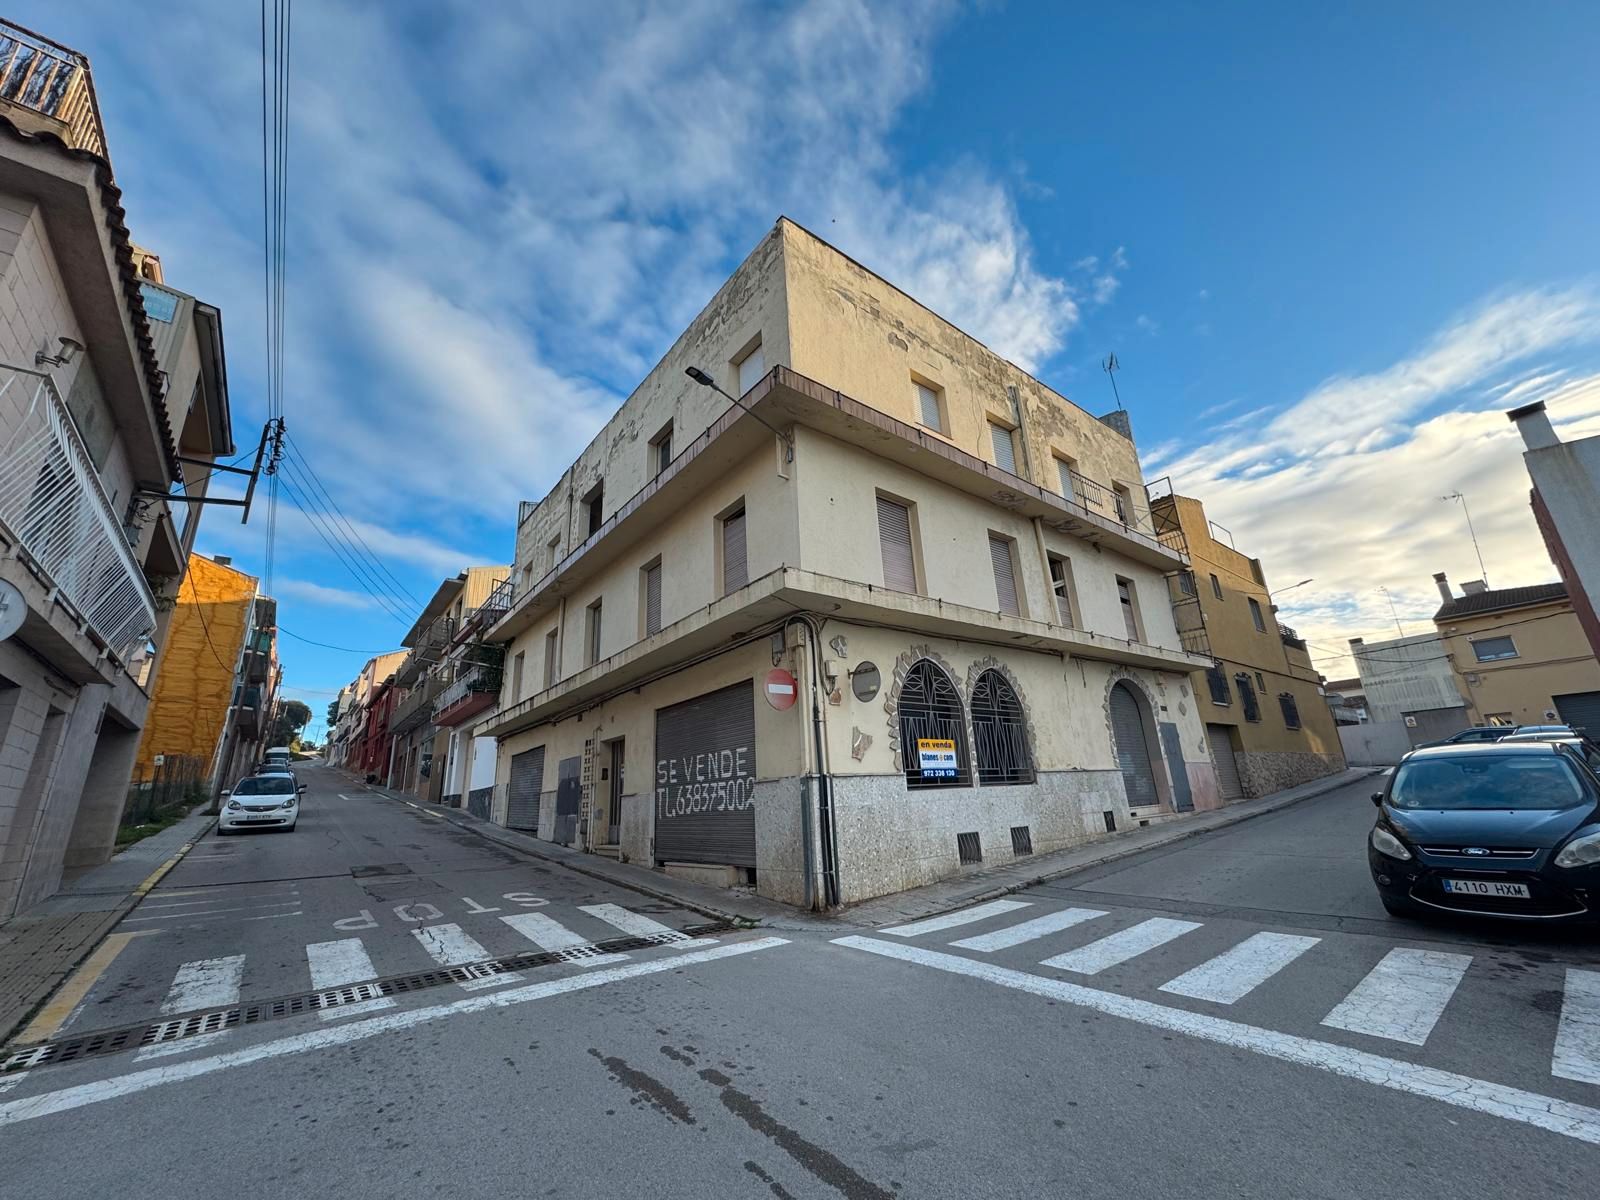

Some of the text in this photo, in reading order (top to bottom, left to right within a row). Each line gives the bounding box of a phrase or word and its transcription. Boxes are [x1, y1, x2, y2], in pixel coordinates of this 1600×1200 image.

[657, 747, 748, 784] SE VENDE
[923, 769, 934, 777] 972
[1454, 881, 1524, 897] 4110 HXM
[332, 892, 551, 931] STOP
